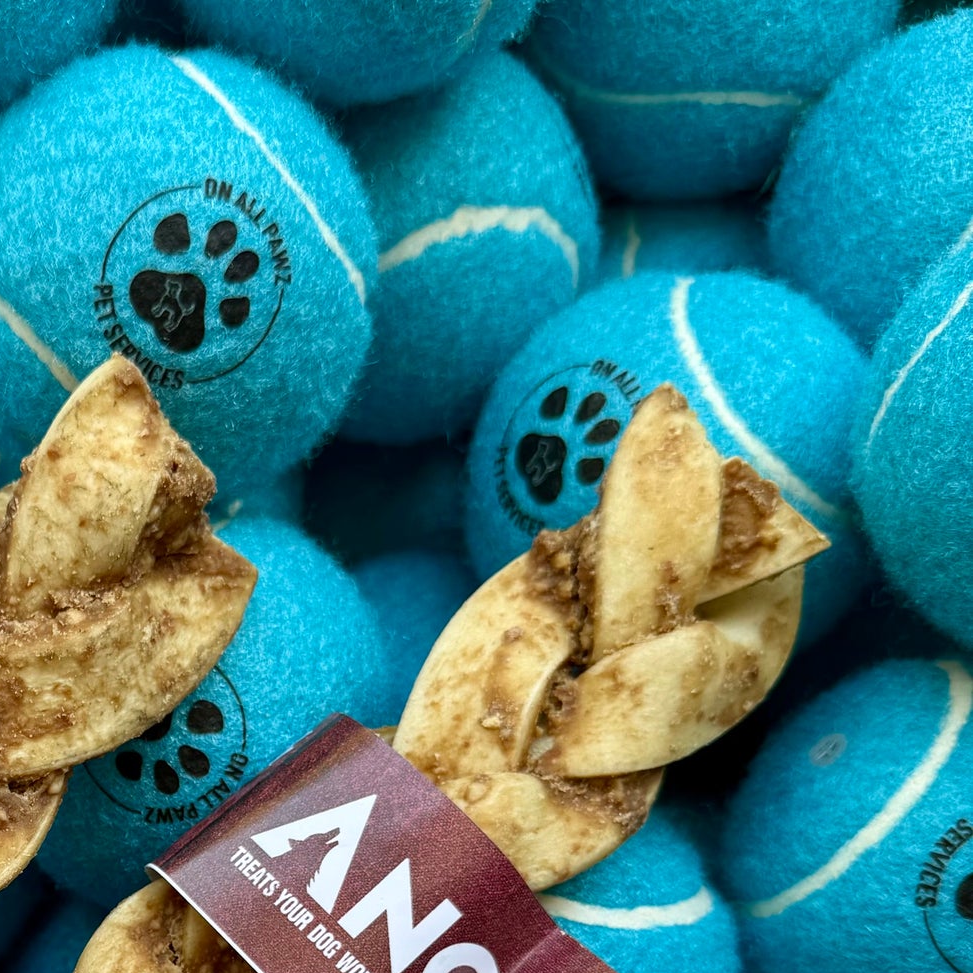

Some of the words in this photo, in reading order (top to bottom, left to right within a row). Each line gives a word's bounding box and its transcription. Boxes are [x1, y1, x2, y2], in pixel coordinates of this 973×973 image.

[205, 177, 233, 200] ON
[235, 191, 266, 228] ALL
[262, 222, 292, 286] PAWZ
[93, 283, 117, 322] PET
[103, 323, 186, 389] SERVICES
[590, 360, 618, 378] ON
[609, 370, 641, 401] ALL
[224, 752, 249, 781] ON
[144, 803, 199, 823] PAWZ
[197, 778, 231, 809] ALL
[915, 818, 973, 907] SERVICES
[230, 846, 280, 897] TREATS
[274, 888, 312, 931] YOUR
[307, 925, 343, 959] DOG
